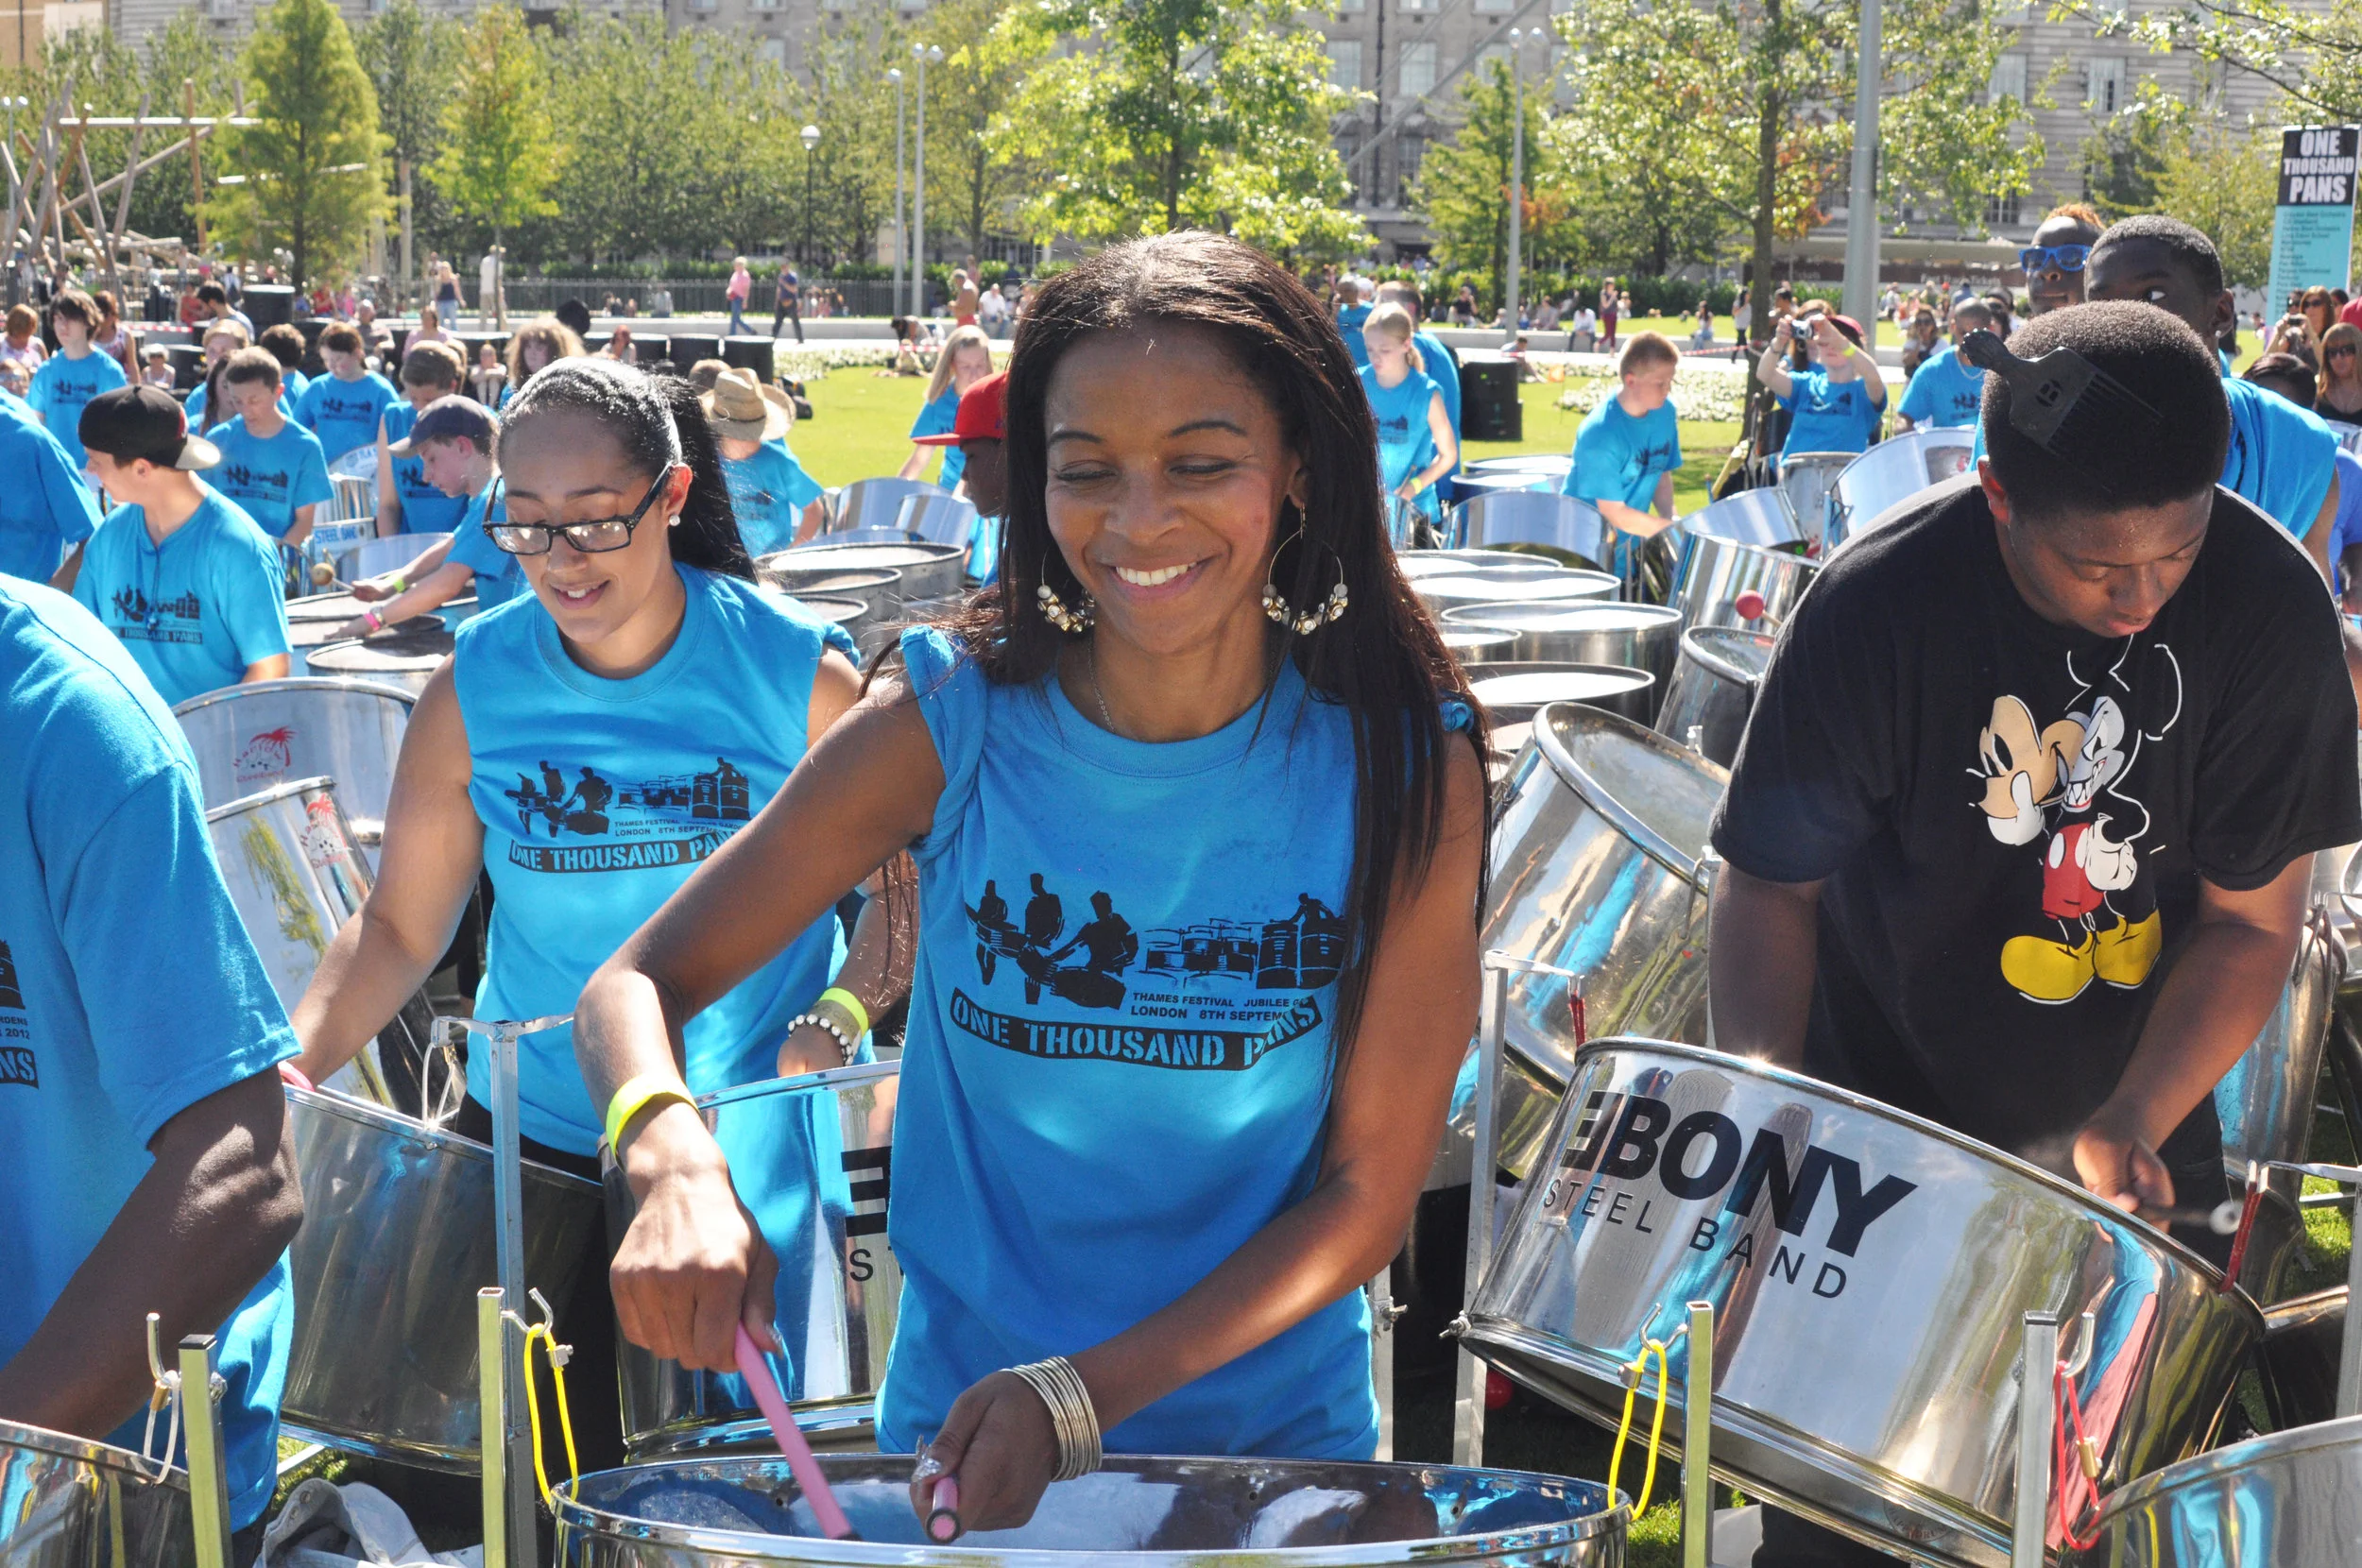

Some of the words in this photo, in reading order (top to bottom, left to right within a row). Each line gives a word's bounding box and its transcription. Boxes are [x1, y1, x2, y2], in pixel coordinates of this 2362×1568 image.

[2300, 130, 2340, 156] ONE
[2284, 157, 2354, 176] THOUSAND
[2289, 176, 2347, 203] PANS
[512, 839, 541, 869] ONE
[550, 843, 679, 870] THOUSAND
[689, 830, 735, 861] PAN
[1133, 992, 1179, 1004] THAMES
[1182, 996, 1234, 1007] FESTIVAL
[1243, 997, 1290, 1008] JUBILEE
[1131, 1005, 1188, 1019] LONDON
[1199, 1011, 1225, 1020] 8TH
[1229, 1011, 1282, 1022] SEPTEM
[5, 1028, 29, 1040] 2012
[952, 996, 1010, 1045] ONE
[1024, 1022, 1225, 1066] THOUSAND
[1560, 1089, 1919, 1258] EBONY
[1544, 1178, 1653, 1234] STEEL
[1688, 1216, 1847, 1300] BAND
